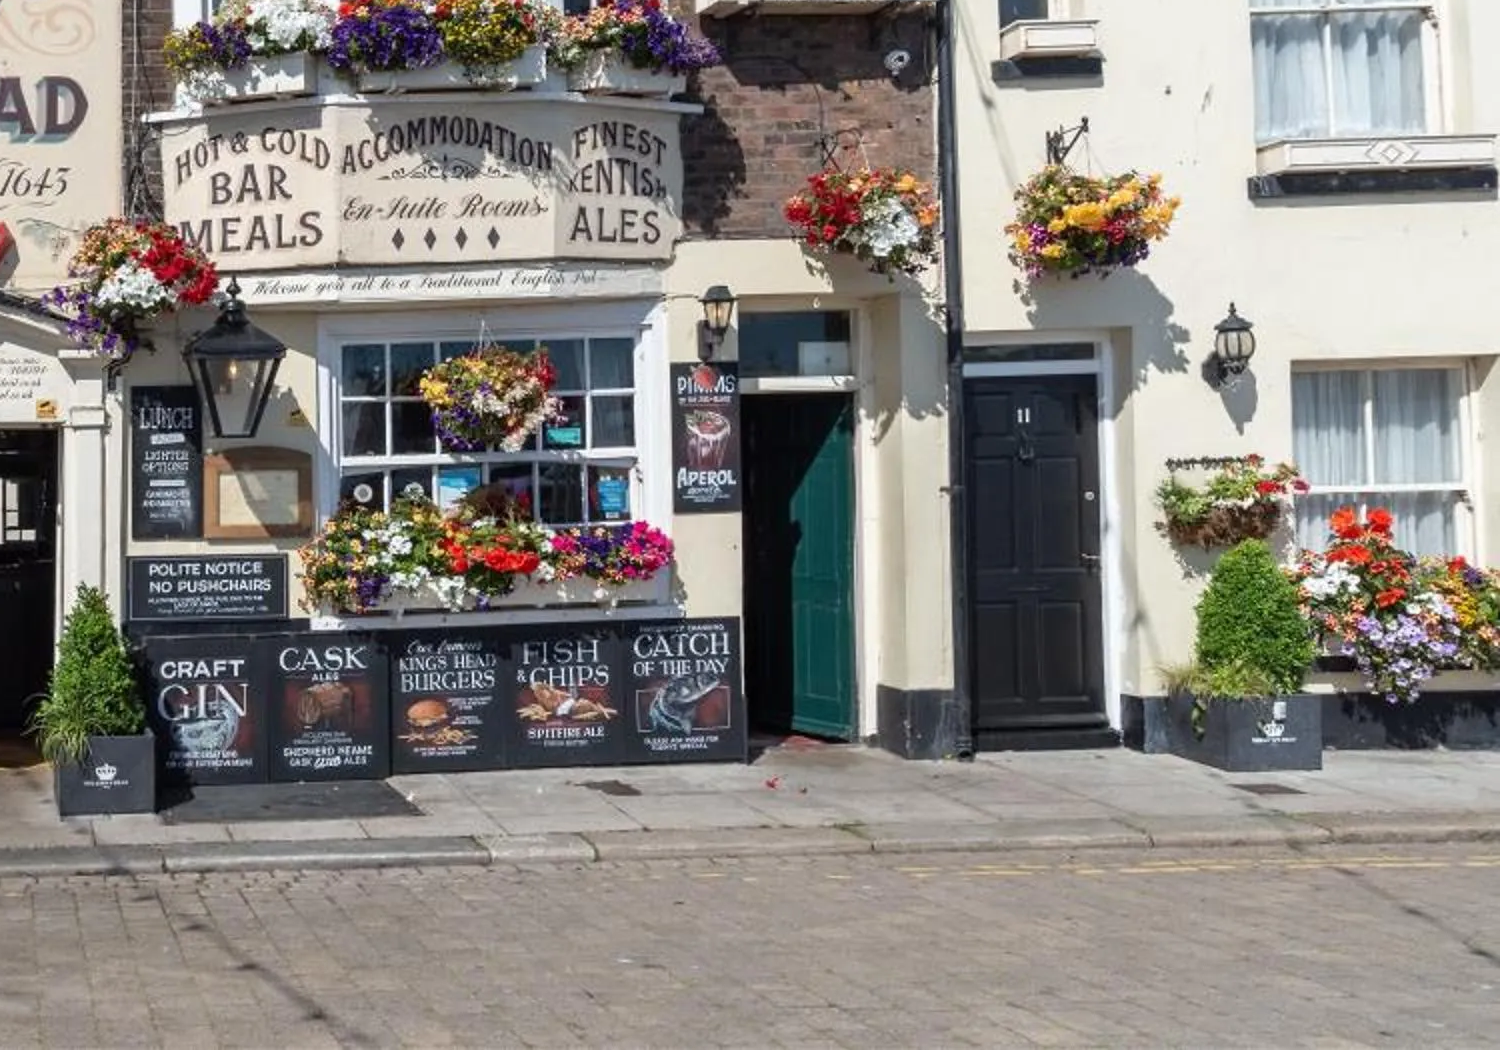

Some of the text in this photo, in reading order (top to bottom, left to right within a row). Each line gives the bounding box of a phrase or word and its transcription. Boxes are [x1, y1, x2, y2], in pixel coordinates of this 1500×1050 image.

[341, 115, 554, 175] ACCOMMODATION
[573, 121, 667, 166] FINEST
[175, 127, 331, 186] HOT & COLD
[211, 163, 293, 204] BAR
[342, 193, 549, 222] En-Suite Rooms
[179, 211, 324, 253] MEALS
[569, 206, 661, 244] ALES
[352, 275, 376, 291] all
[380, 278, 395, 289] to
[399, 278, 411, 289] a
[140, 407, 193, 429] LUNCH
[141, 462, 189, 472] OPTIONS
[145, 450, 190, 461] LIGHTER
[677, 467, 737, 489] APEROL
[149, 561, 262, 577] POLITE NOTICE
[149, 578, 272, 594] NO PUSHCHAIRS
[522, 639, 600, 664] FISH
[633, 632, 731, 659] CATCH
[161, 659, 245, 679] CRAFT
[279, 646, 367, 671] CASK
[454, 653, 498, 669] HEAD
[633, 657, 730, 677] OF THE DAY
[311, 671, 340, 682] ALES
[401, 670, 496, 693] BURGERS
[516, 664, 610, 688] & CHIPS
[158, 683, 248, 721] GIN
[528, 726, 605, 739] SPITFIRE ALE
